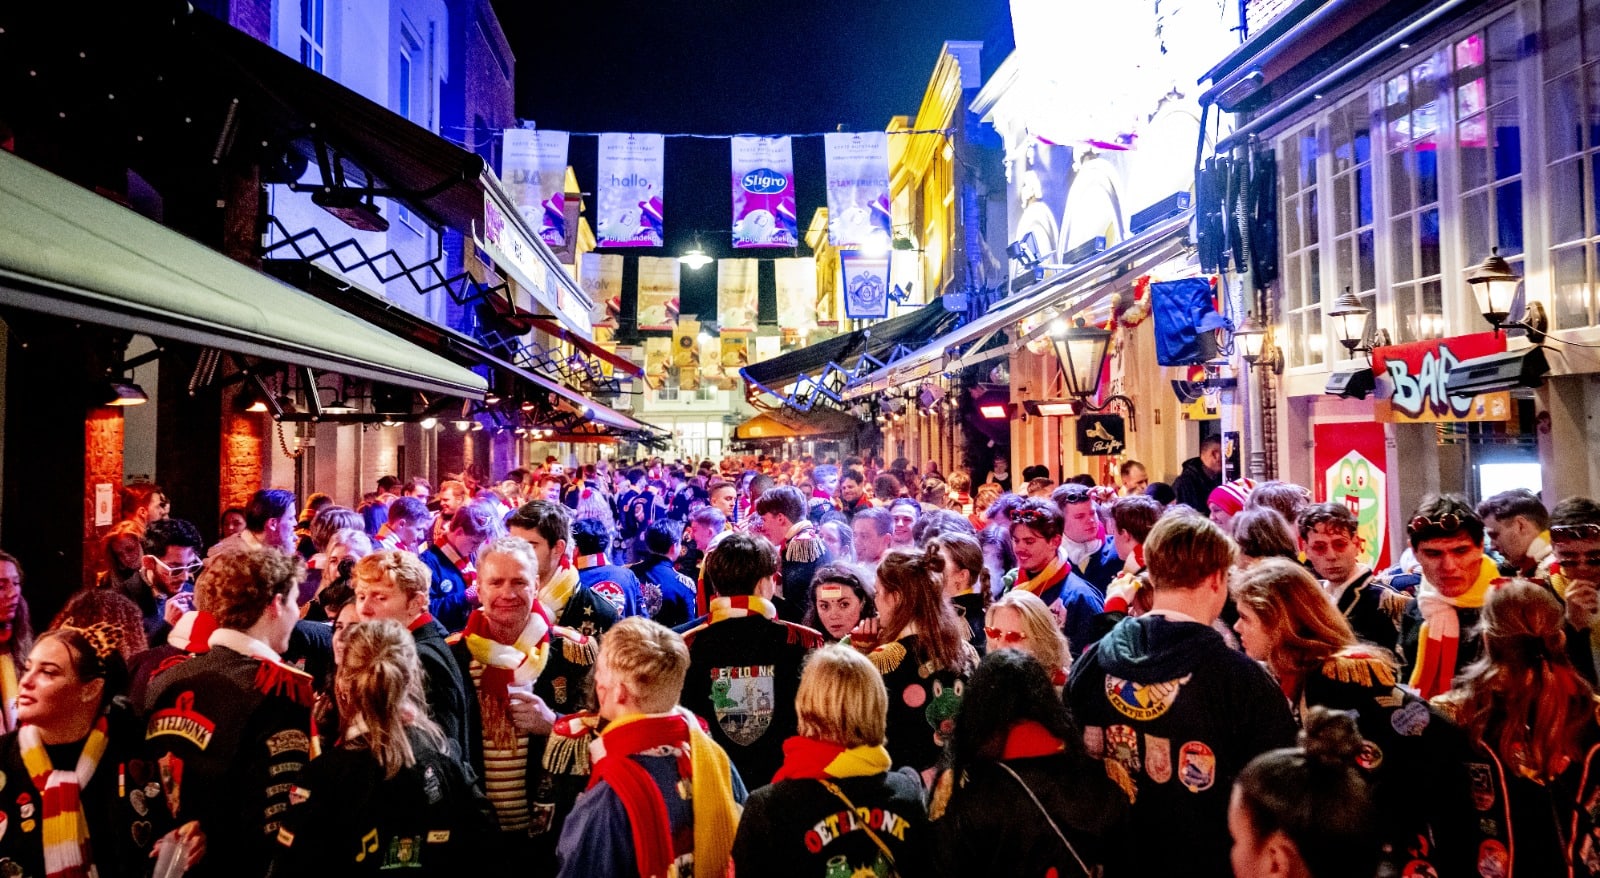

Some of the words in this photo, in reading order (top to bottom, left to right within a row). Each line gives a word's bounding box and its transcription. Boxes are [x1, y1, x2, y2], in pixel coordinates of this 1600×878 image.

[611, 173, 652, 190] hallo,
[744, 174, 786, 188] Sligro
[711, 665, 774, 679] OETELDONK
[1112, 695, 1144, 719] EENTJE
[804, 806, 911, 853] OETELDONK
